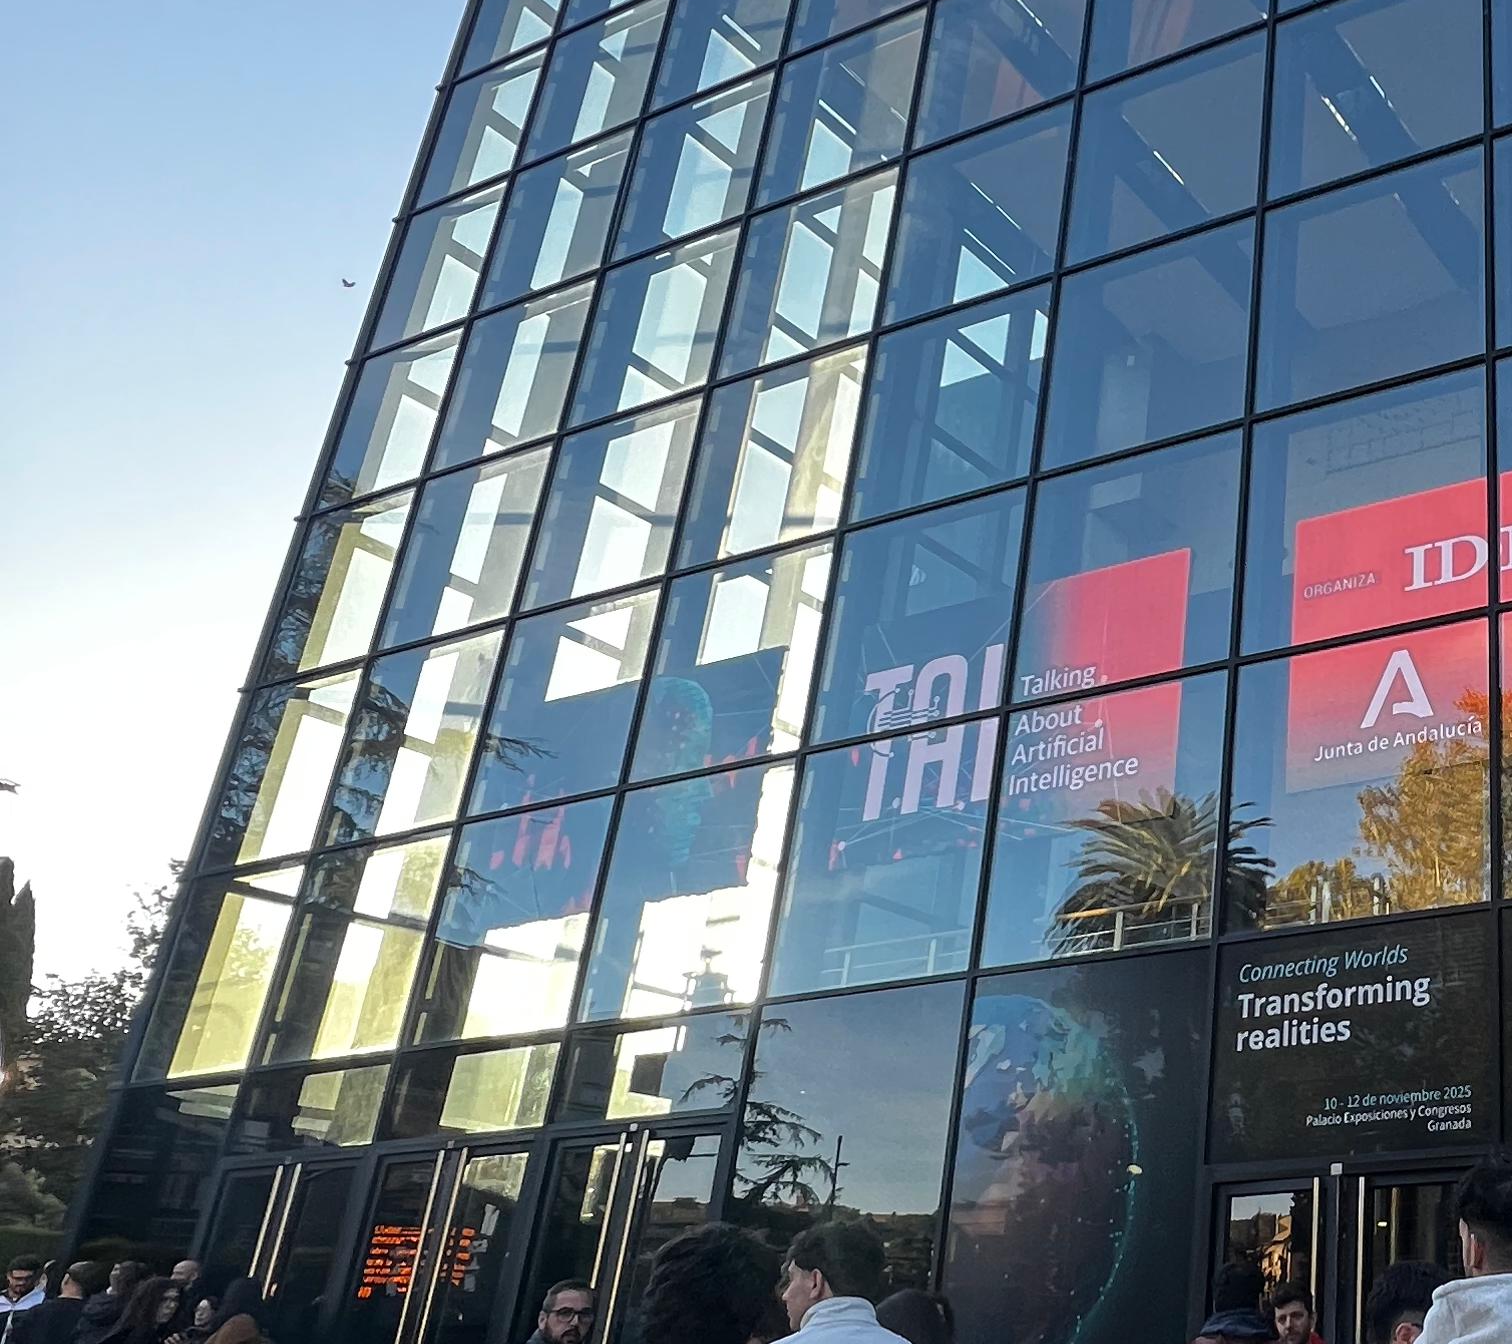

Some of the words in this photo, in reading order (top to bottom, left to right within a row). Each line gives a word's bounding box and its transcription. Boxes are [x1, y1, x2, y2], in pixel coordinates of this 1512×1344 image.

[1303, 572, 1376, 598] ORGANIZA
[1021, 665, 1097, 697] Talking
[1014, 705, 1083, 736] About
[1011, 727, 1105, 766] Artificial
[1314, 741, 1363, 762] Junta
[1368, 736, 1389, 752] de
[1393, 716, 1482, 747] Andalucía
[1008, 757, 1139, 796] Intelligence
[1239, 955, 1339, 983] Connecting
[1344, 944, 1409, 970] Worlds
[1237, 975, 1432, 1019] Transforming
[1235, 1017, 1351, 1052] realities
[1324, 1096, 1338, 1110] 10
[1347, 1095, 1360, 1108] 12
[1362, 1093, 1377, 1107] de
[1379, 1088, 1441, 1105] noviembre
[1443, 1085, 1472, 1100] 2025
[1306, 1113, 1342, 1127] Palacio
[1343, 1108, 1408, 1126] Exposiciones
[1409, 1108, 1417, 1121] y
[1418, 1103, 1472, 1119] Congresos
[1427, 1117, 1472, 1132] Granada
